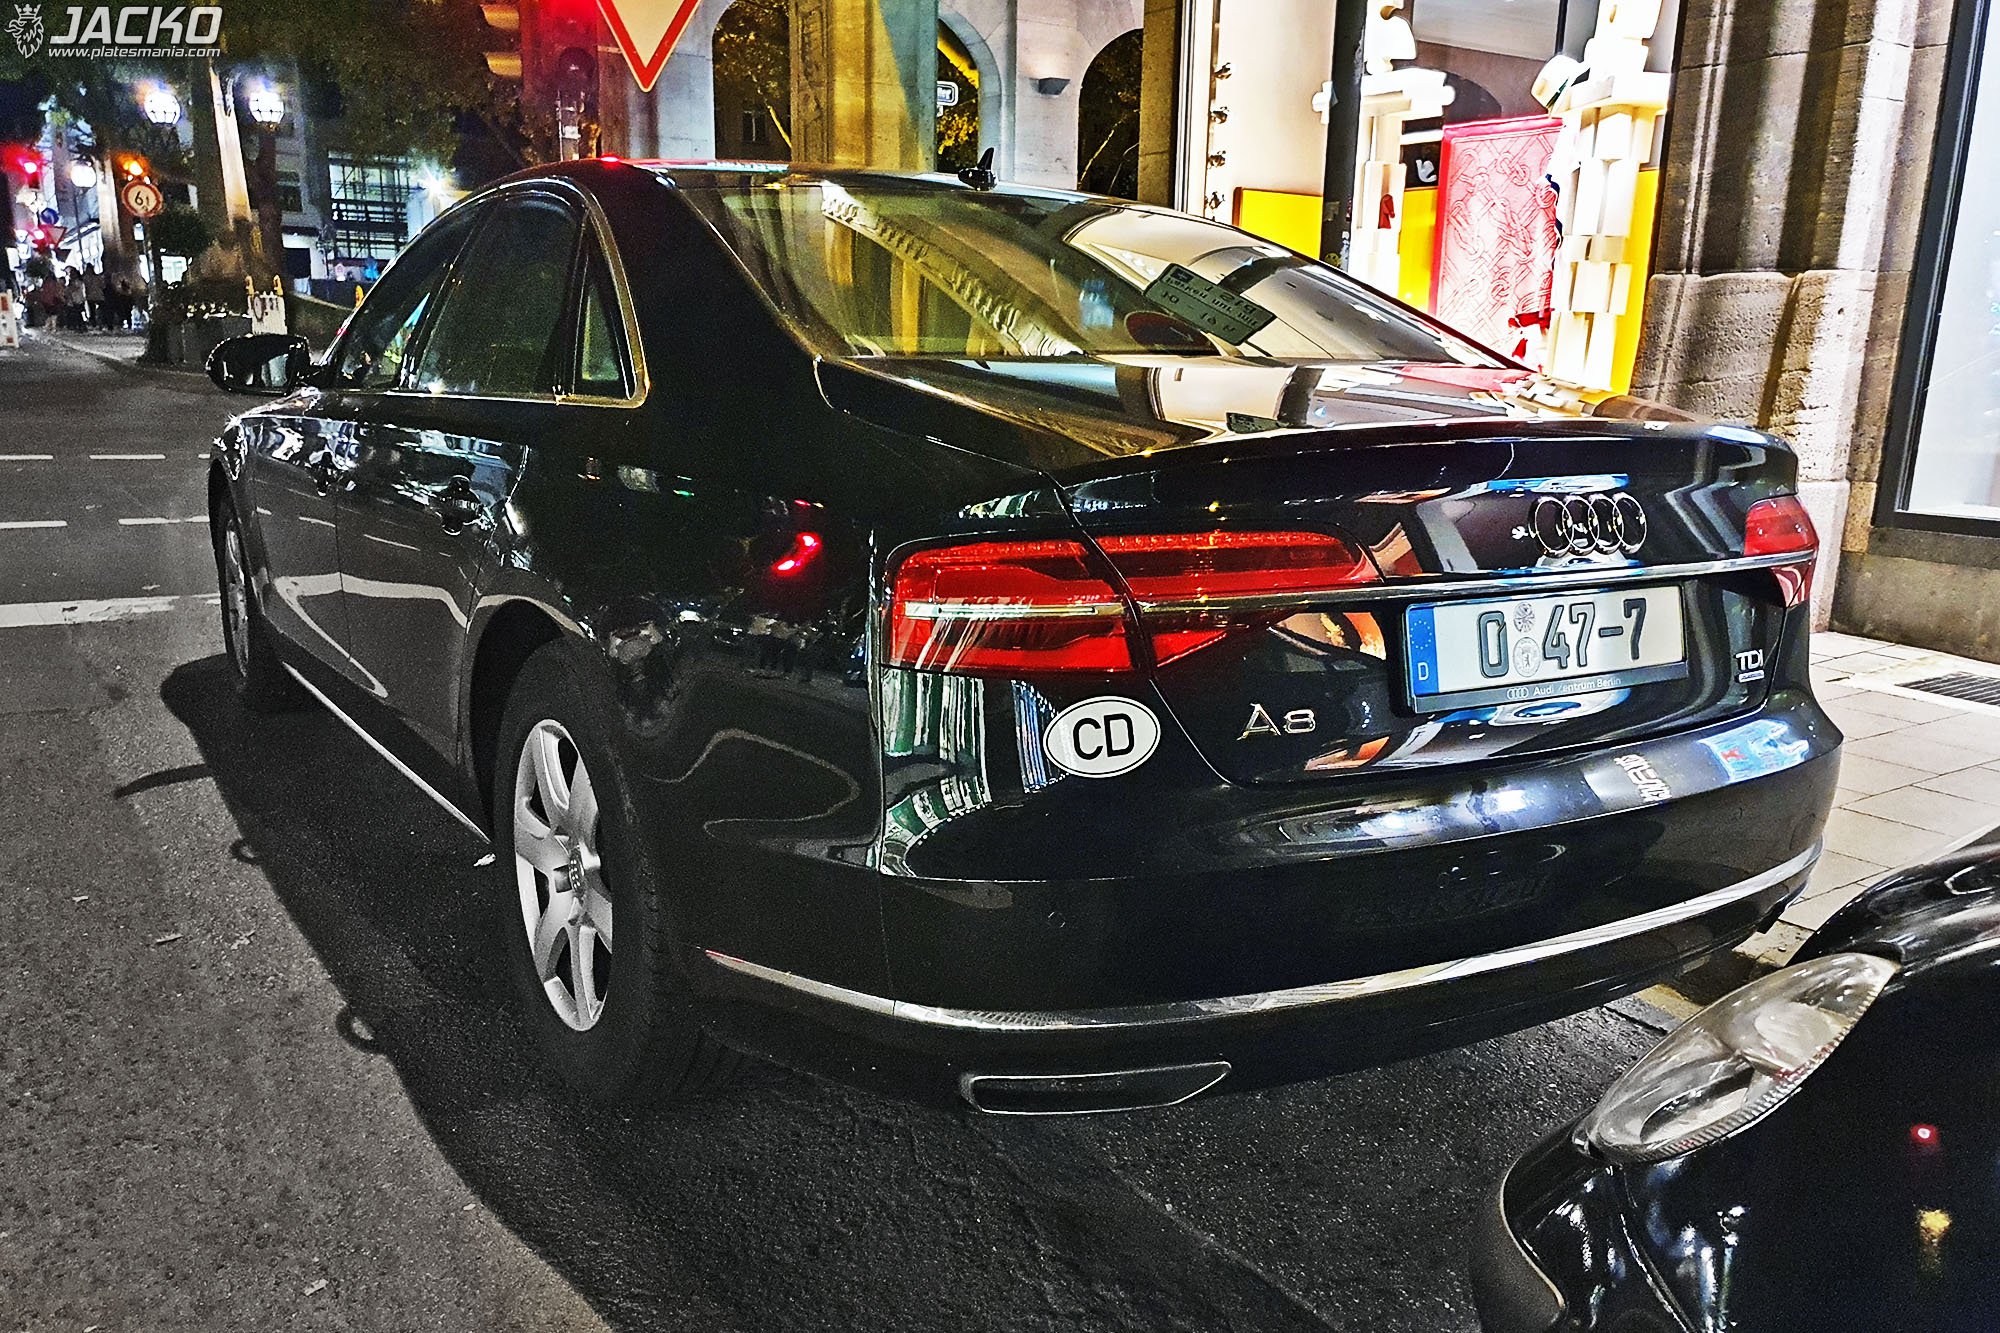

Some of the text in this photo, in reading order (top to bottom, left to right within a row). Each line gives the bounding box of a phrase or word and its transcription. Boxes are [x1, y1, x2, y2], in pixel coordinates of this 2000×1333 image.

[1418, 661, 1429, 681] D
[1735, 649, 1764, 671] TDI
[1533, 684, 1554, 697] Audi
[1596, 677, 1622, 688] Berlin
[1236, 702, 1316, 741] A8
[1073, 712, 1136, 760] CD
